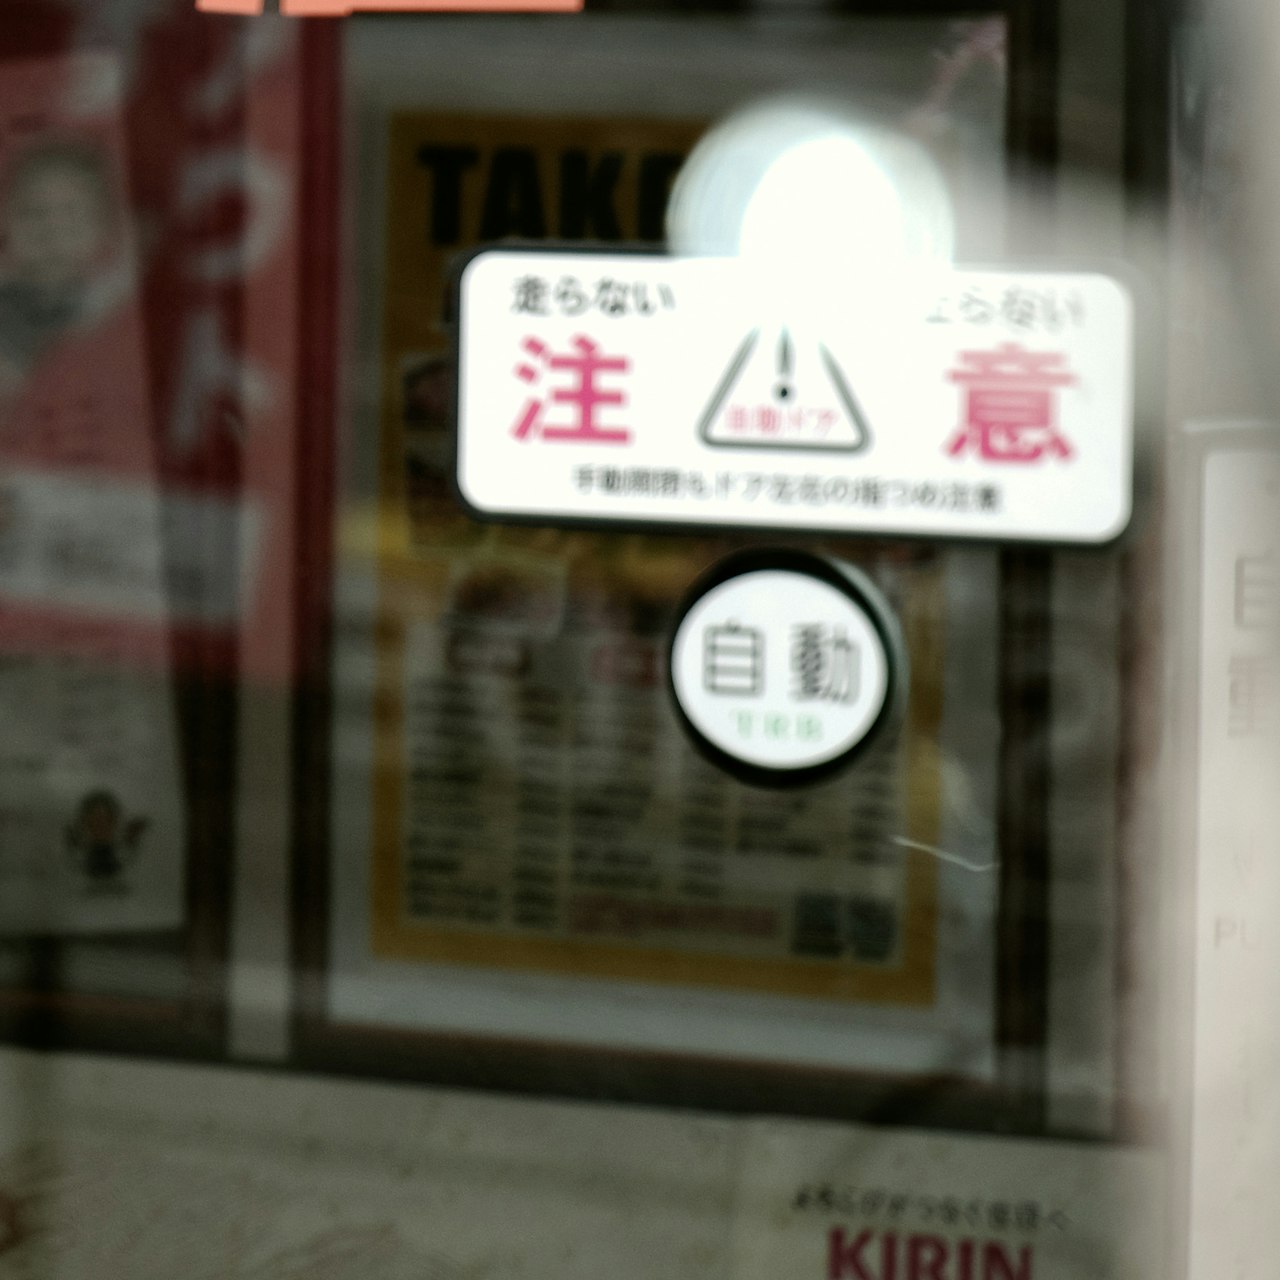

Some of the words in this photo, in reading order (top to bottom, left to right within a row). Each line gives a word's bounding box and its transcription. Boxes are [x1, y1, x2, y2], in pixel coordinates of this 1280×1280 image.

[509, 333, 634, 447] 注
[943, 341, 1081, 466] 意
[702, 619, 866, 705] 自動
